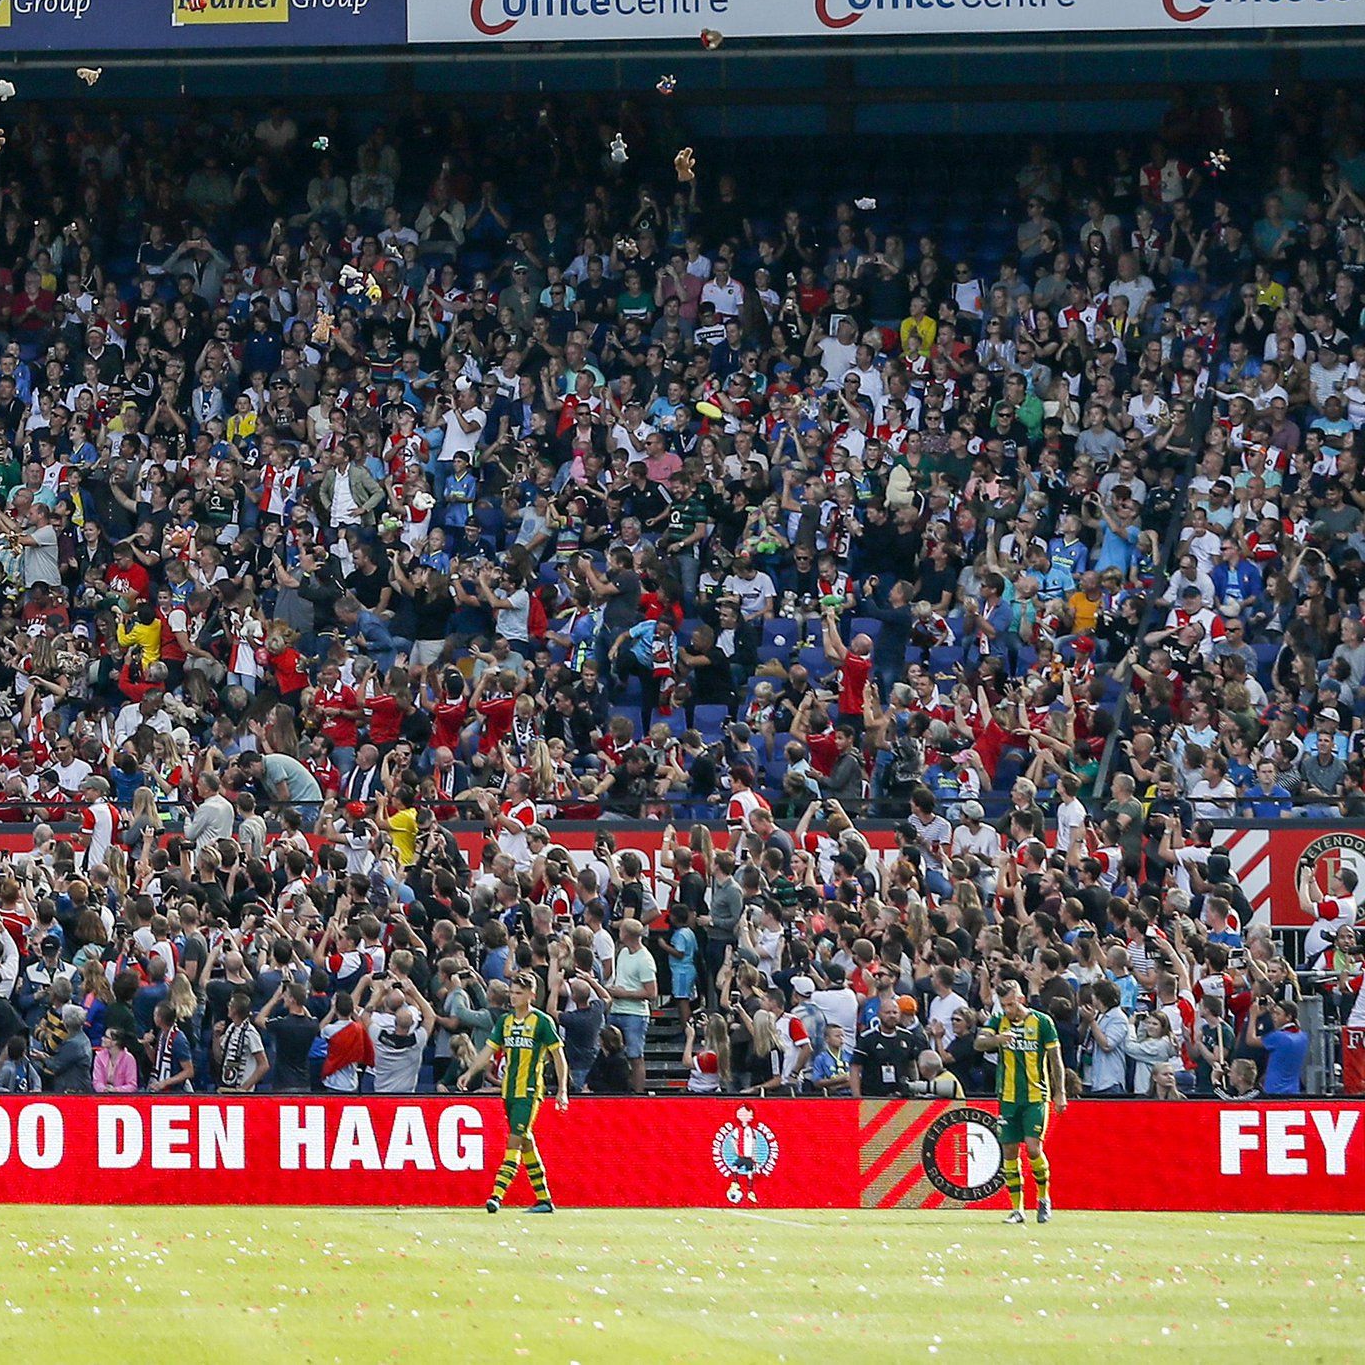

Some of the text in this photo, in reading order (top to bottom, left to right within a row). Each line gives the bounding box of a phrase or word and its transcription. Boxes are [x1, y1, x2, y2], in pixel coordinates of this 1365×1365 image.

[97, 1105, 246, 1170] DEN
[279, 1105, 484, 1172] HAAG
[1219, 1109, 1363, 1176] FEY
